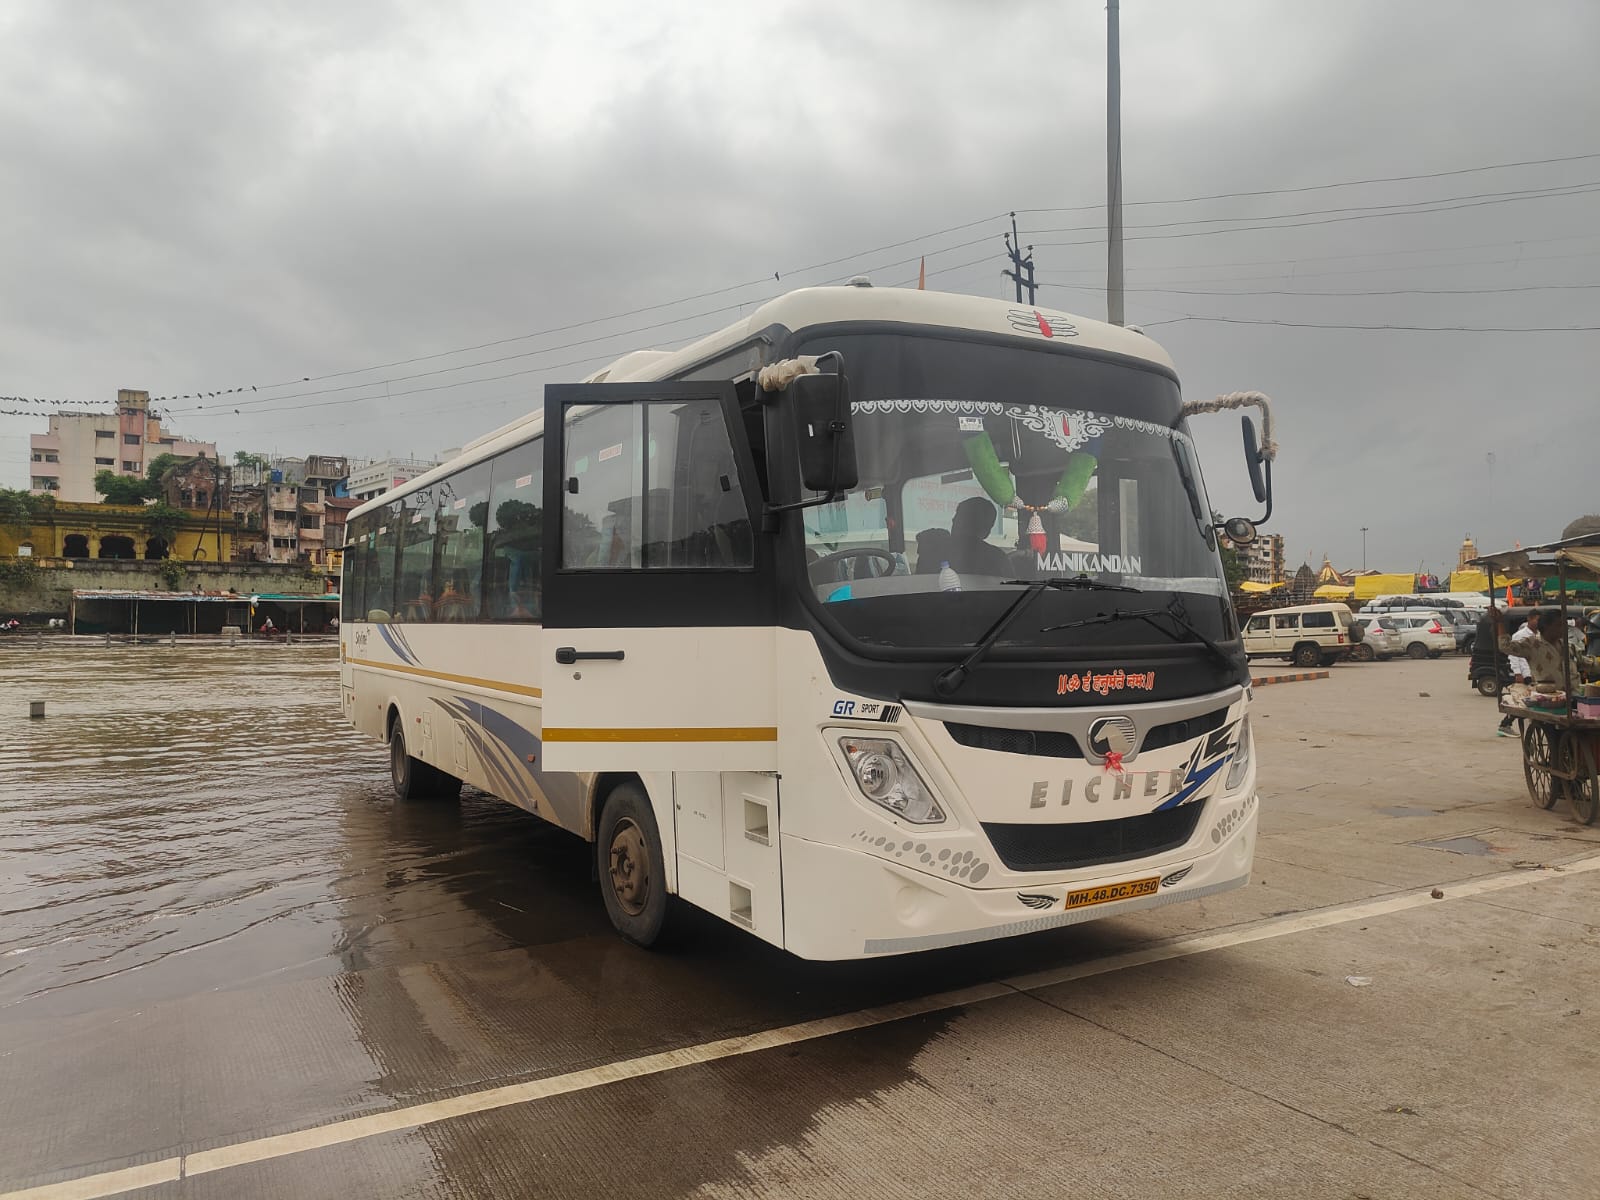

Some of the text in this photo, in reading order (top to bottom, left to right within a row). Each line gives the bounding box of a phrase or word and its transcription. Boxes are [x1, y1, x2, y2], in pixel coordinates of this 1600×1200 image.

[1036, 552, 1142, 574] MANIKANDAN
[833, 700, 880, 716] GR SPORT
[1029, 768, 1187, 809] EICHER
[1068, 880, 1158, 906] MH.48.DC.7350
